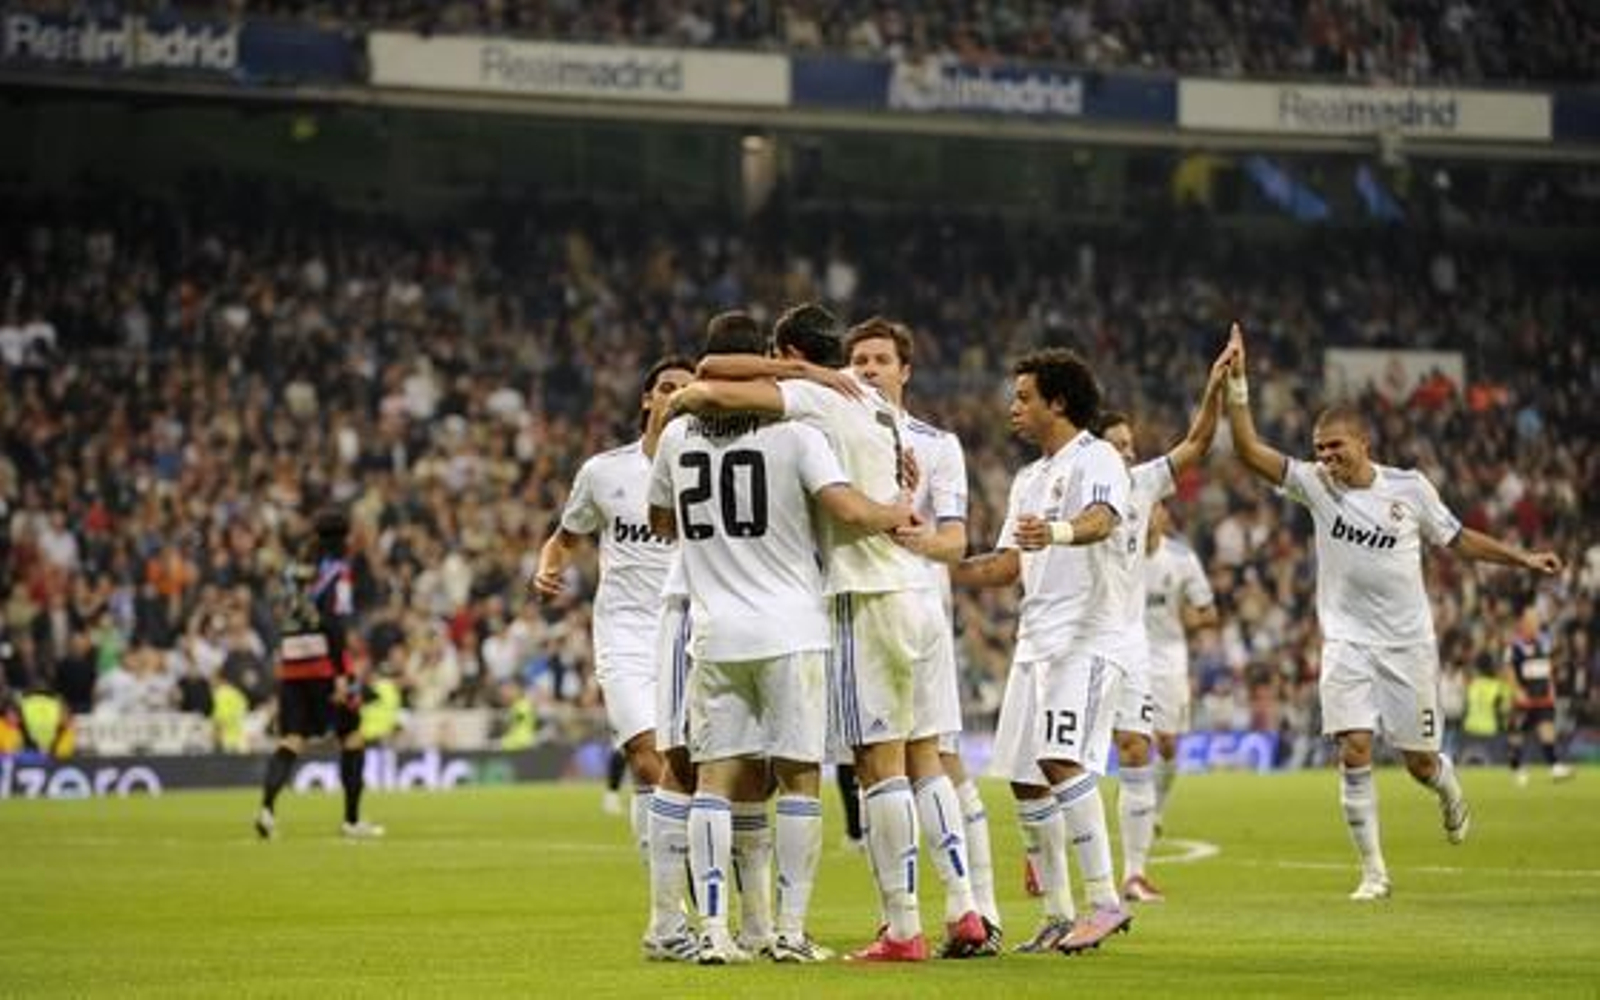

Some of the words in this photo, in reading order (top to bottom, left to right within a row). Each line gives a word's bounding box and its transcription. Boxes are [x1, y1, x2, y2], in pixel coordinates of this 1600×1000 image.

[479, 45, 684, 92] Realmadrid
[679, 450, 769, 540] 20
[614, 516, 672, 546] bw
[1331, 514, 1397, 549] bwin
[1045, 709, 1077, 745] 12
[1422, 709, 1434, 737] 3
